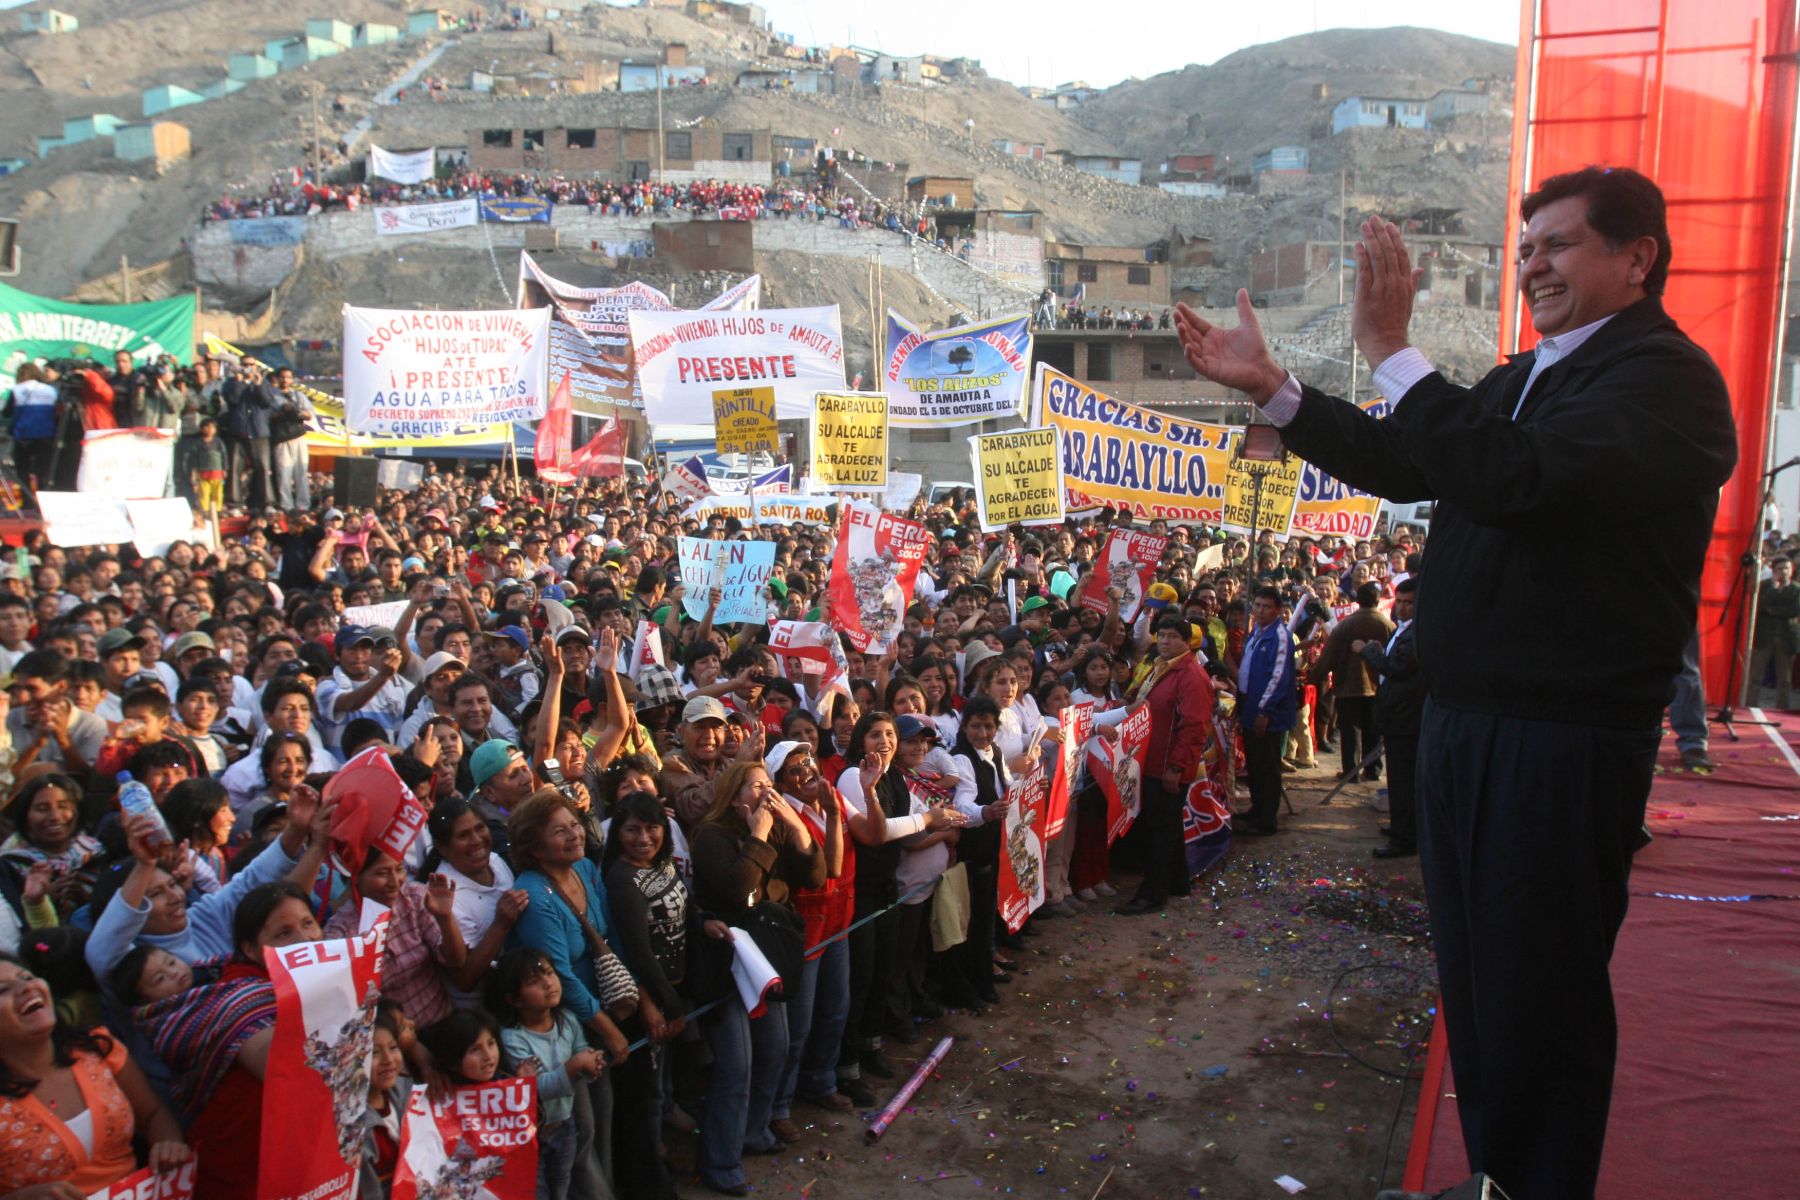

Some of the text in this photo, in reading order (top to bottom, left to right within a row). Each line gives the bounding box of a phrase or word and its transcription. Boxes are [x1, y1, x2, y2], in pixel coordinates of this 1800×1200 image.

[18, 311, 136, 350] MONTERREY
[468, 318, 482, 331] DE
[673, 318, 719, 344] VIVIENDA
[722, 317, 765, 336] HIJOS
[770, 324, 783, 333] DE
[788, 325, 833, 356] AMAUTA
[461, 342, 471, 353] DE
[443, 357, 477, 368] ATE
[678, 355, 797, 384] PRESENTE
[372, 392, 432, 407] AGUA
[441, 389, 484, 406] PARA
[920, 390, 991, 404] DE AMAUTA A
[369, 408, 415, 420] DECRETO
[715, 397, 775, 427] PUNTILLA
[819, 399, 884, 413] CARABAYLLO
[890, 405, 917, 415] UNDADO
[920, 406, 929, 415] EL
[932, 406, 937, 415] 5
[940, 406, 951, 415] DE
[954, 402, 994, 414] OCTUBRE
[996, 400, 1012, 411] DEL
[1049, 379, 1163, 433] GRACIAS
[1166, 422, 1210, 447] SR.
[391, 421, 450, 434] GRACIAS
[471, 408, 522, 423] RESIDENTE
[732, 417, 759, 427] CREADO
[850, 415, 854, 423] Y
[818, 424, 883, 439] SU ALCALDE
[745, 440, 771, 452] CLARA
[843, 442, 857, 453] TE
[982, 432, 1053, 452] CARABAYLLO
[817, 454, 882, 465] AGRADECEN
[1016, 450, 1021, 458] Y
[819, 470, 878, 482] POR LA LUZ
[985, 457, 1053, 478] SU ALCALDE
[1229, 461, 1297, 481] CARABAYLLO
[676, 466, 711, 494] ALAN
[1014, 478, 1029, 488] TE
[1226, 474, 1238, 487] TE
[1241, 478, 1297, 498] AGADECE
[989, 488, 1056, 505] AGRADECEN
[1240, 493, 1274, 510] SEOR
[695, 507, 752, 523] VIVIENDA
[760, 505, 801, 519] SANTA
[851, 511, 873, 529] EL
[988, 502, 1058, 521] POR EL AGUA
[1152, 505, 1222, 522] TODOS
[890, 537, 924, 551] ES UNO
[1115, 530, 1129, 541] EL
[897, 549, 922, 560] SOLO
[1141, 552, 1159, 561] SOLO
[1147, 547, 1161, 556] UNO
[726, 576, 737, 586] DE
[774, 623, 795, 648] EL
[1074, 704, 1094, 723] PER
[1123, 703, 1150, 738] PERÚ
[1130, 720, 1150, 740] ES UNO
[1135, 728, 1150, 744] SOLO
[284, 942, 342, 970] EL
[434, 1078, 531, 1118] PERÚ
[462, 1113, 530, 1132] ES UNO
[479, 1130, 532, 1147] SOLO
